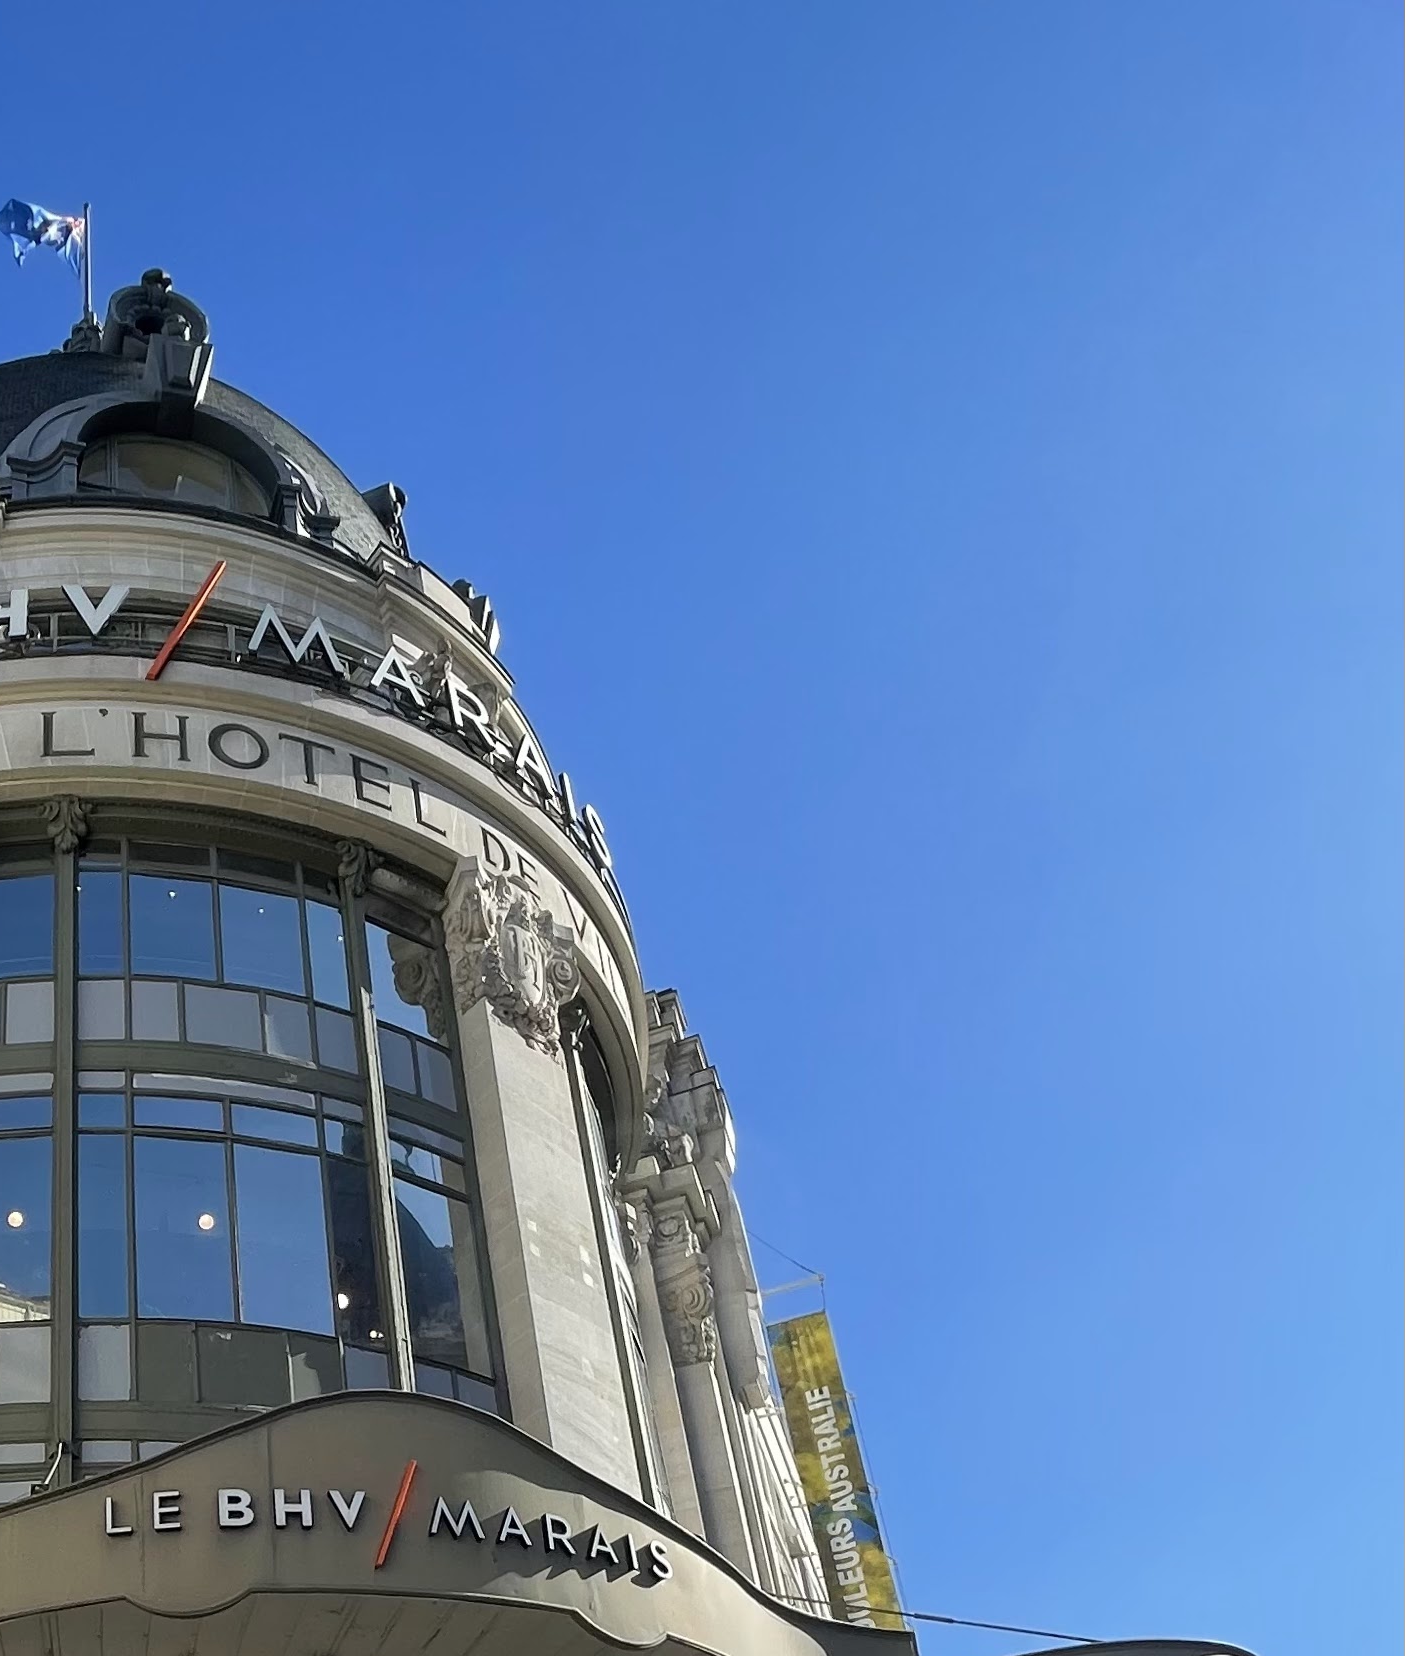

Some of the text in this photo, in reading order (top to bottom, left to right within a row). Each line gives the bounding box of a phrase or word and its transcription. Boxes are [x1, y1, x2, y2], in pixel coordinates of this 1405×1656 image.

[248, 602, 613, 868] MARAIS
[480, 824, 542, 902] DE
[105, 1490, 182, 1538] LE
[217, 1488, 366, 1532] BHV
[428, 1496, 674, 1581] MARAIS
[805, 1385, 878, 1628] ULEURS AUSTRALIE
